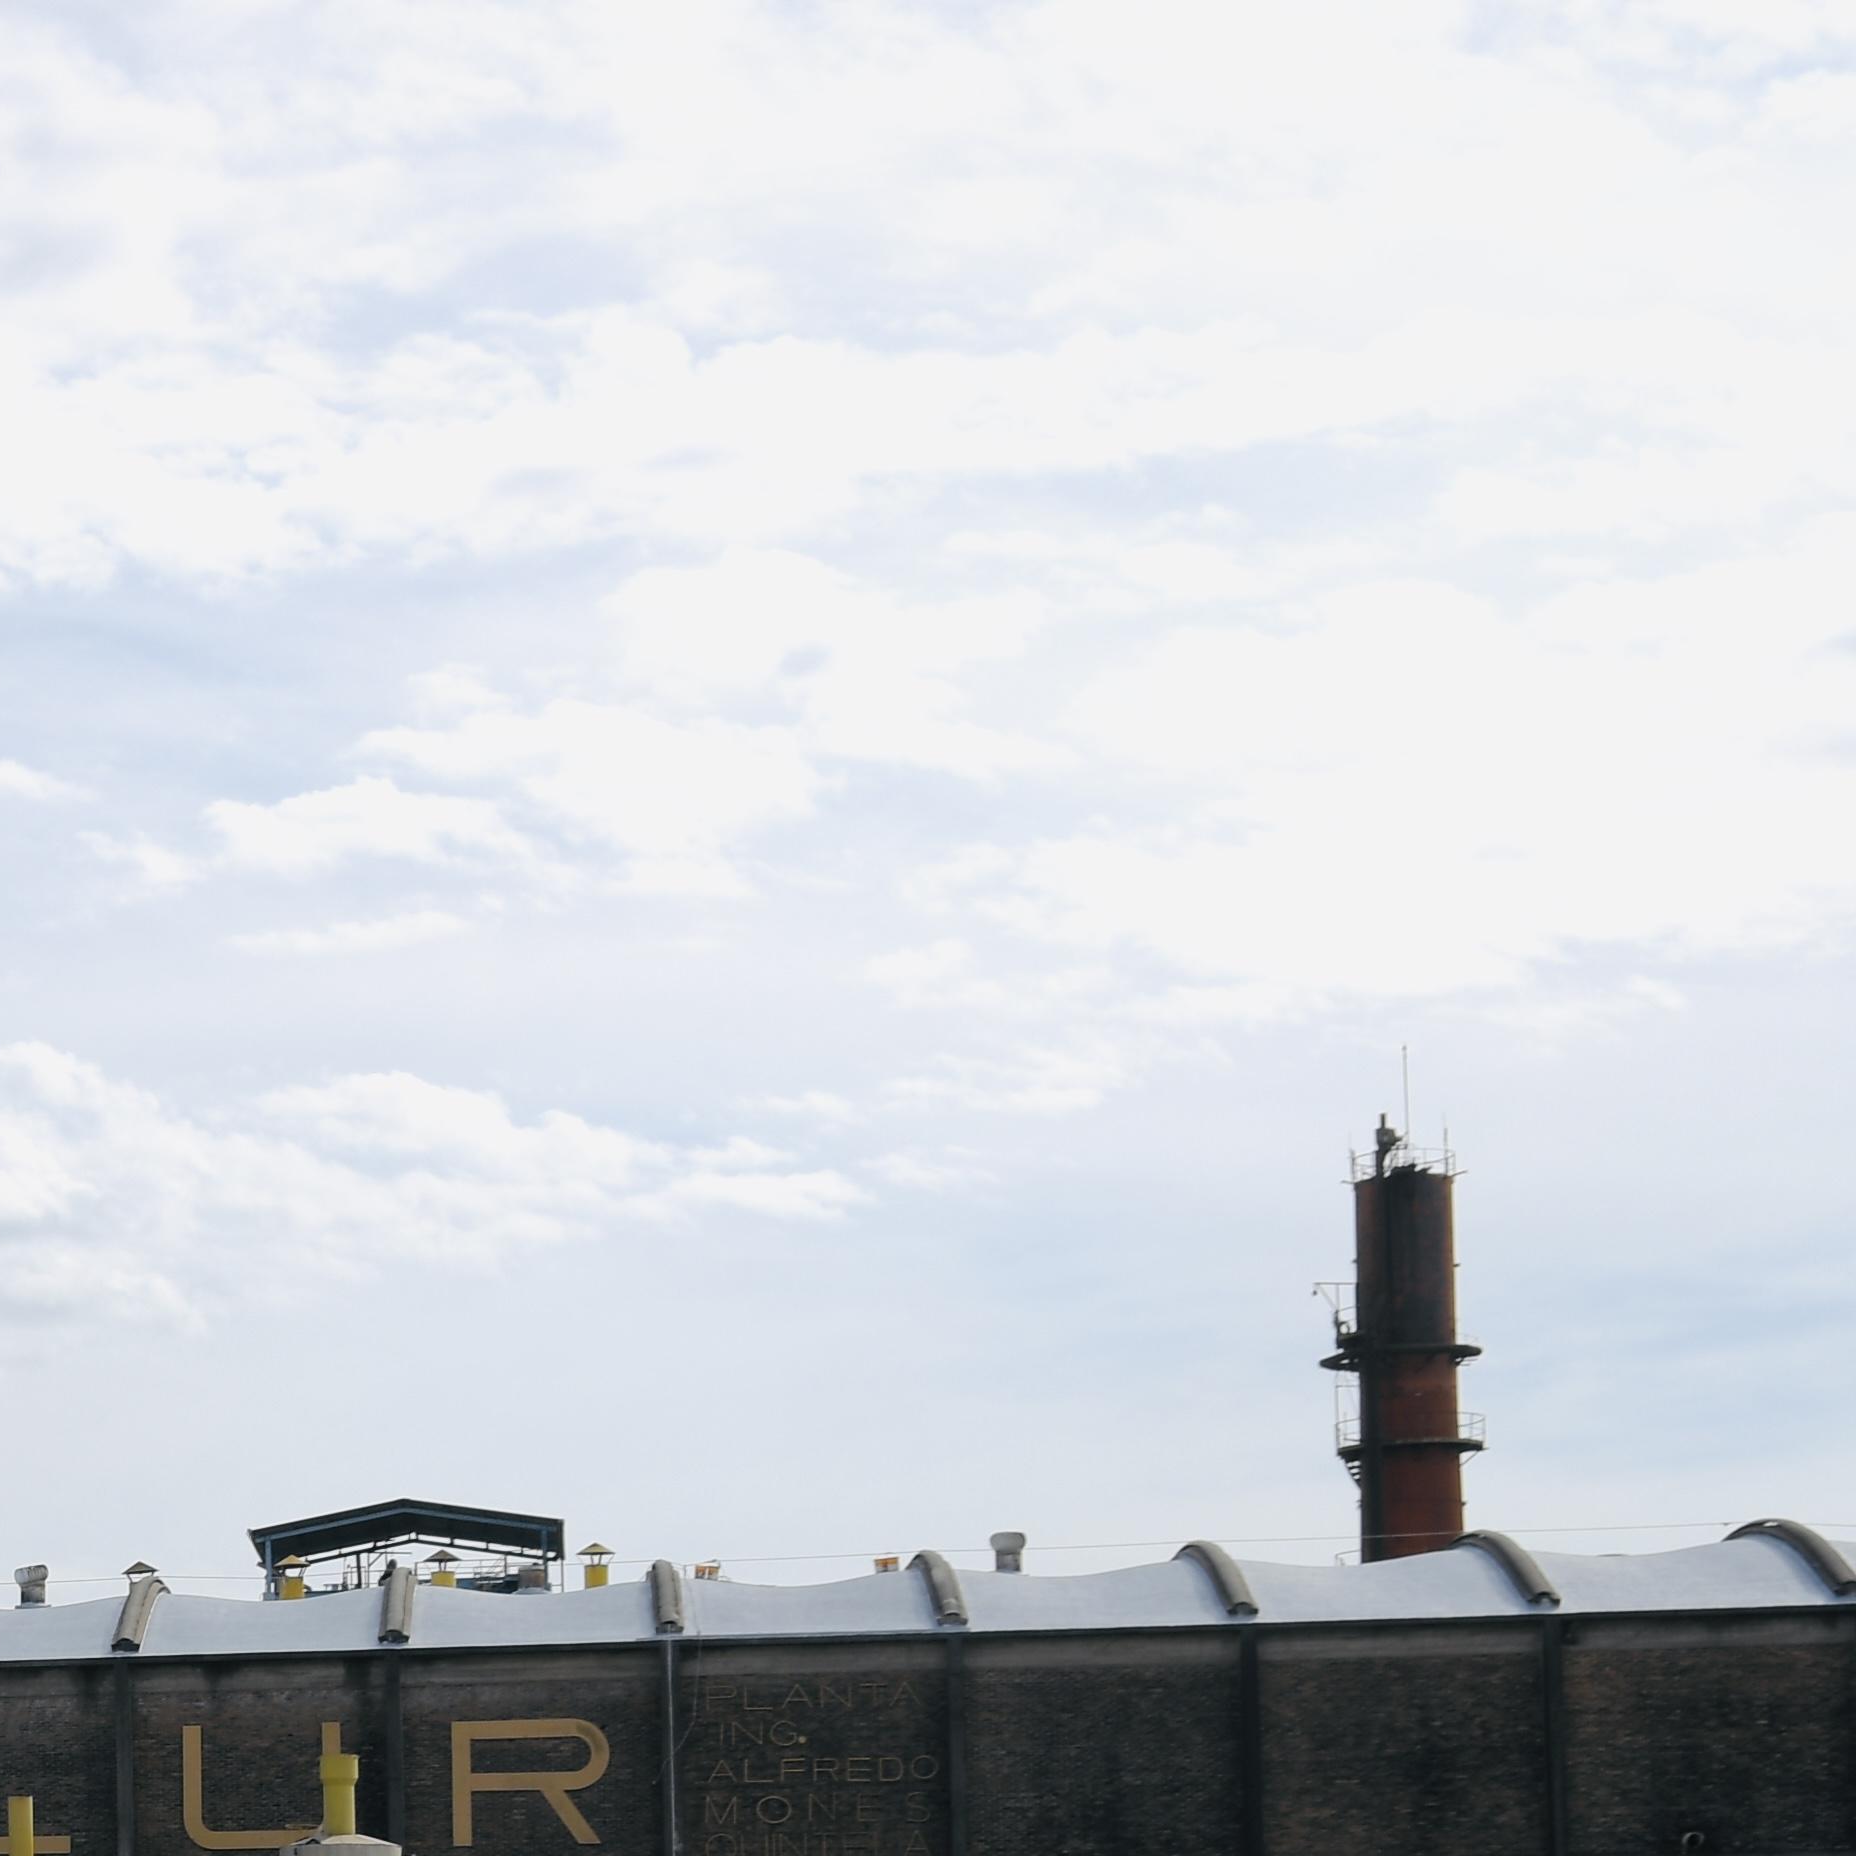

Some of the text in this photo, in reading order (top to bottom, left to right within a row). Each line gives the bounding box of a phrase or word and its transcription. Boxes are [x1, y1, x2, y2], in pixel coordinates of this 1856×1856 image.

[705, 1681, 921, 1710] PLANTA
[719, 1720, 807, 1746] ING.
[708, 1755, 938, 1783] ALFREDO
[705, 1792, 930, 1824] MONES
